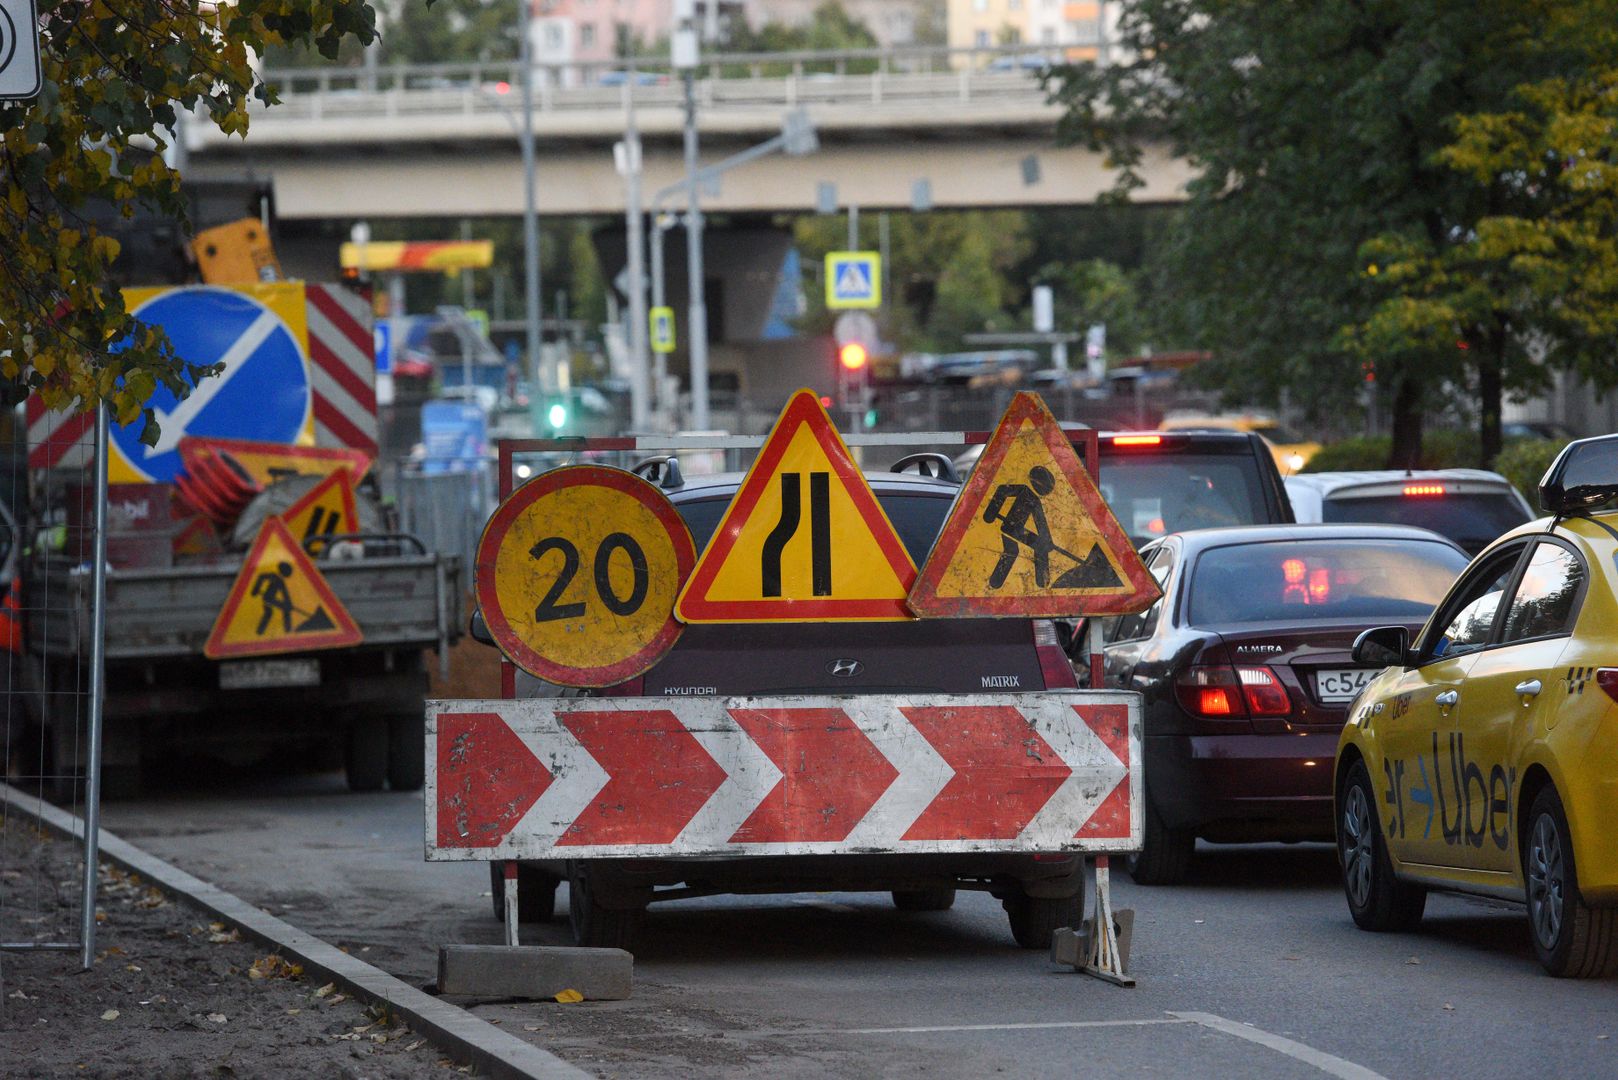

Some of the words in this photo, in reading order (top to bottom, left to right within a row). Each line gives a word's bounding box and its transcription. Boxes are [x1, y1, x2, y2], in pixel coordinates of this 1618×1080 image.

[528, 531, 649, 623] 20
[1236, 645, 1283, 653] ALMERA
[981, 675, 1020, 688] MATRIX
[664, 686, 717, 695] HYUNDAI
[1433, 732, 1516, 850] Uber
